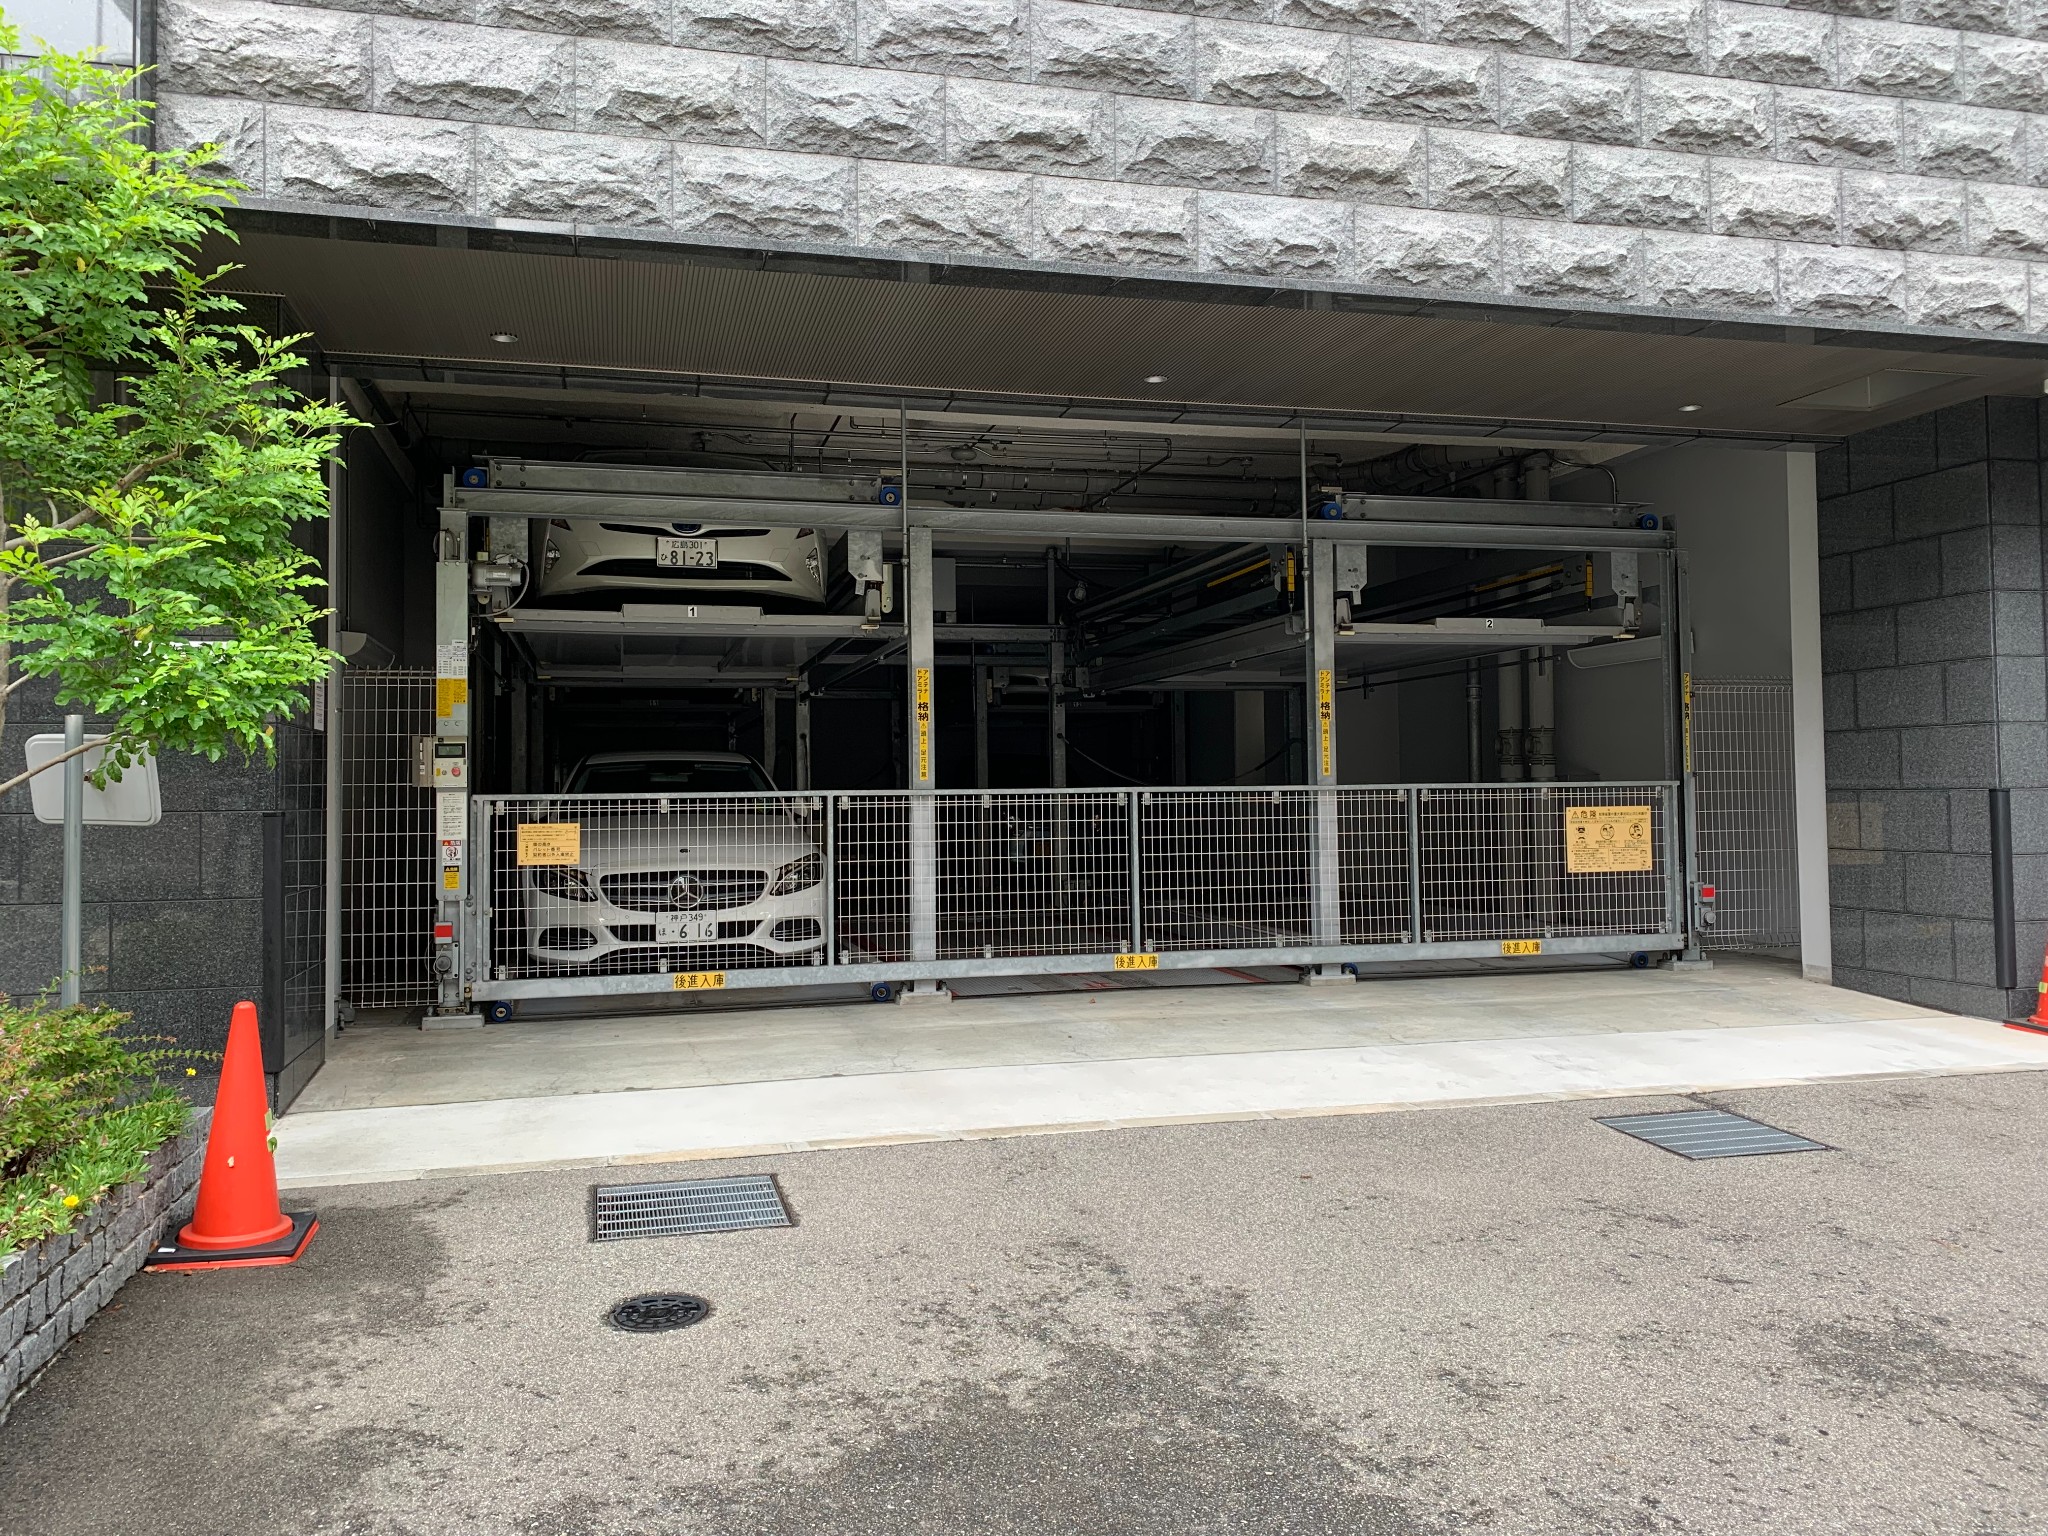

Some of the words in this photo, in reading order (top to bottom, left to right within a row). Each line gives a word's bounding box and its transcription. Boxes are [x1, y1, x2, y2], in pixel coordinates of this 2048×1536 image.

[670, 550, 714, 566] 81-23
[689, 606, 695, 617] 1
[1486, 619, 1493, 628] 2
[917, 702, 929, 722] 格納
[1320, 701, 1331, 720] 格納
[1502, 941, 1541, 954] 後進入庫
[1115, 955, 1158, 969] 後進入庫
[674, 973, 725, 989] 後進入庫
